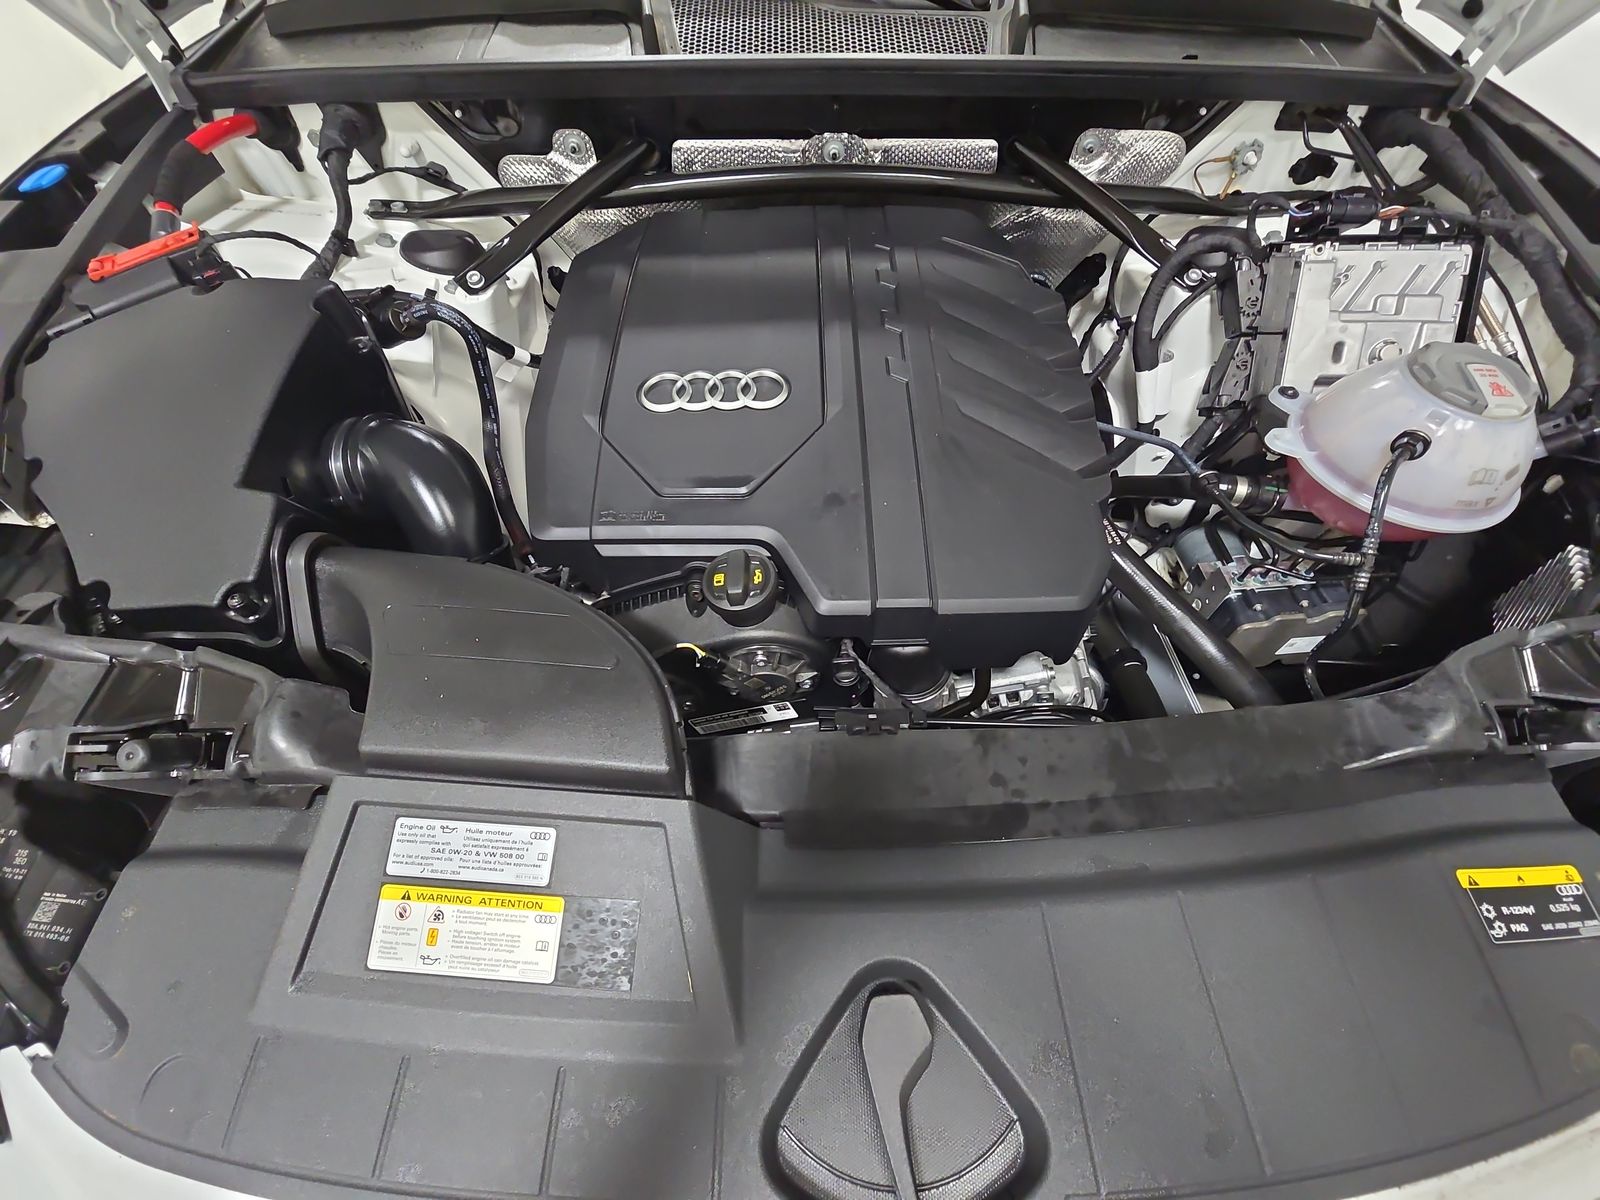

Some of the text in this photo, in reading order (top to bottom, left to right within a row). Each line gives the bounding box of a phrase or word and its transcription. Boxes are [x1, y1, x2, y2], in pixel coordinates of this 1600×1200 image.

[416, 892, 544, 910] WARNING ATTENTION
[1501, 905, 1536, 916] R-1234yf
[1569, 902, 1581, 913] kg
[1509, 923, 1529, 933] PAG
